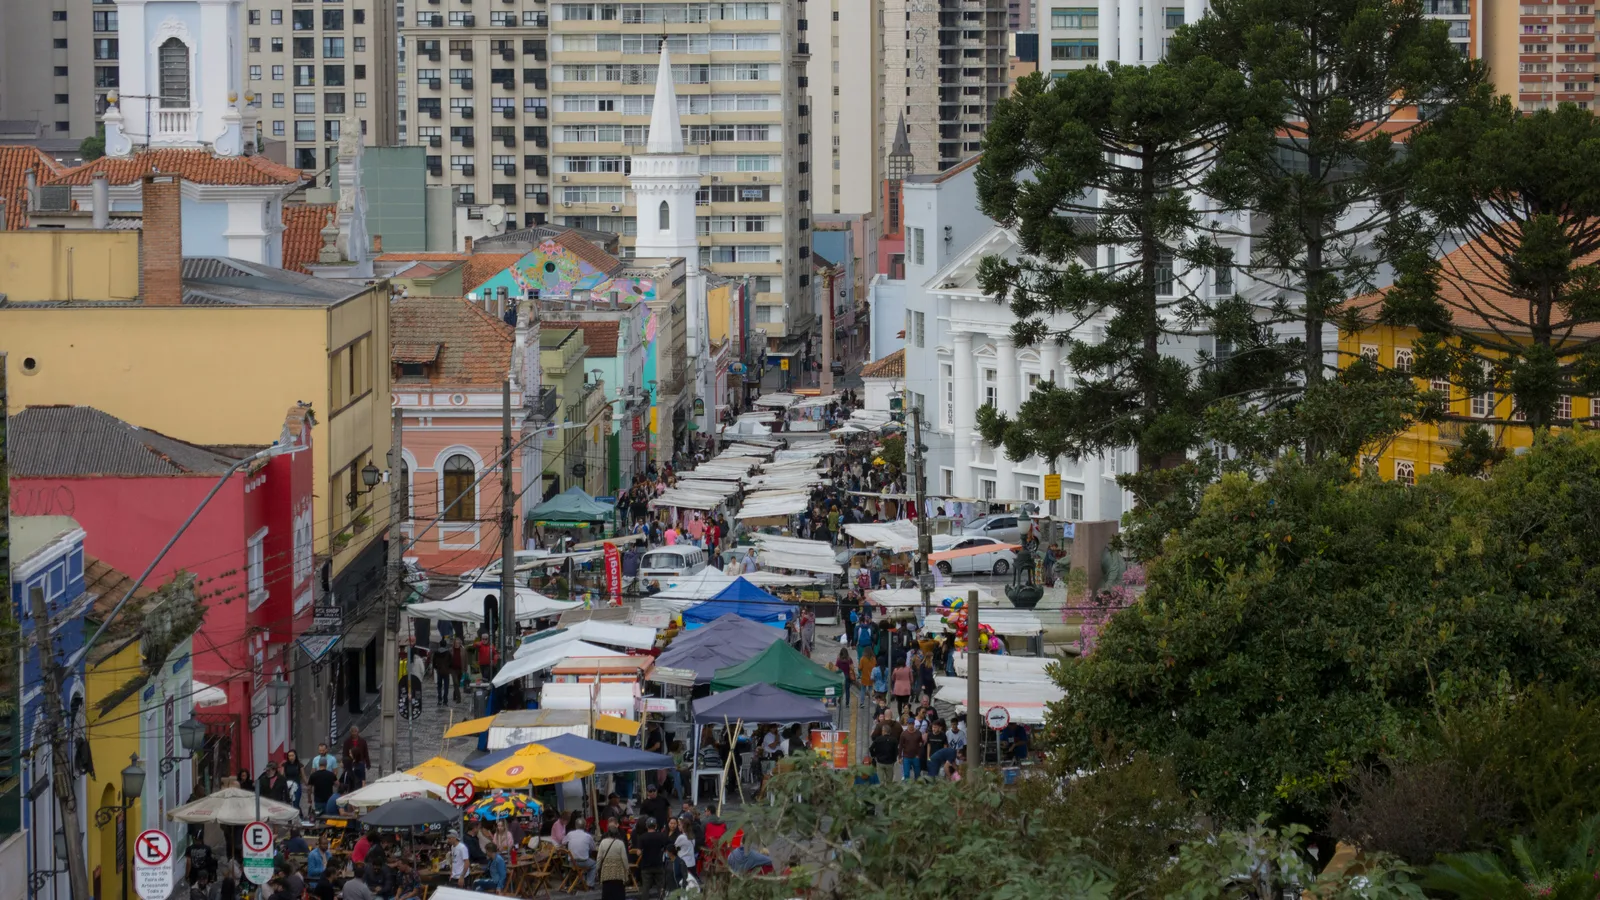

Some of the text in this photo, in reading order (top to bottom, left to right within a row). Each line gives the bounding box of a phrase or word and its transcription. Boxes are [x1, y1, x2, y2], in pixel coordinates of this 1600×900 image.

[429, 823, 441, 831] elo
[252, 828, 263, 845] E
[146, 837, 159, 858] E
